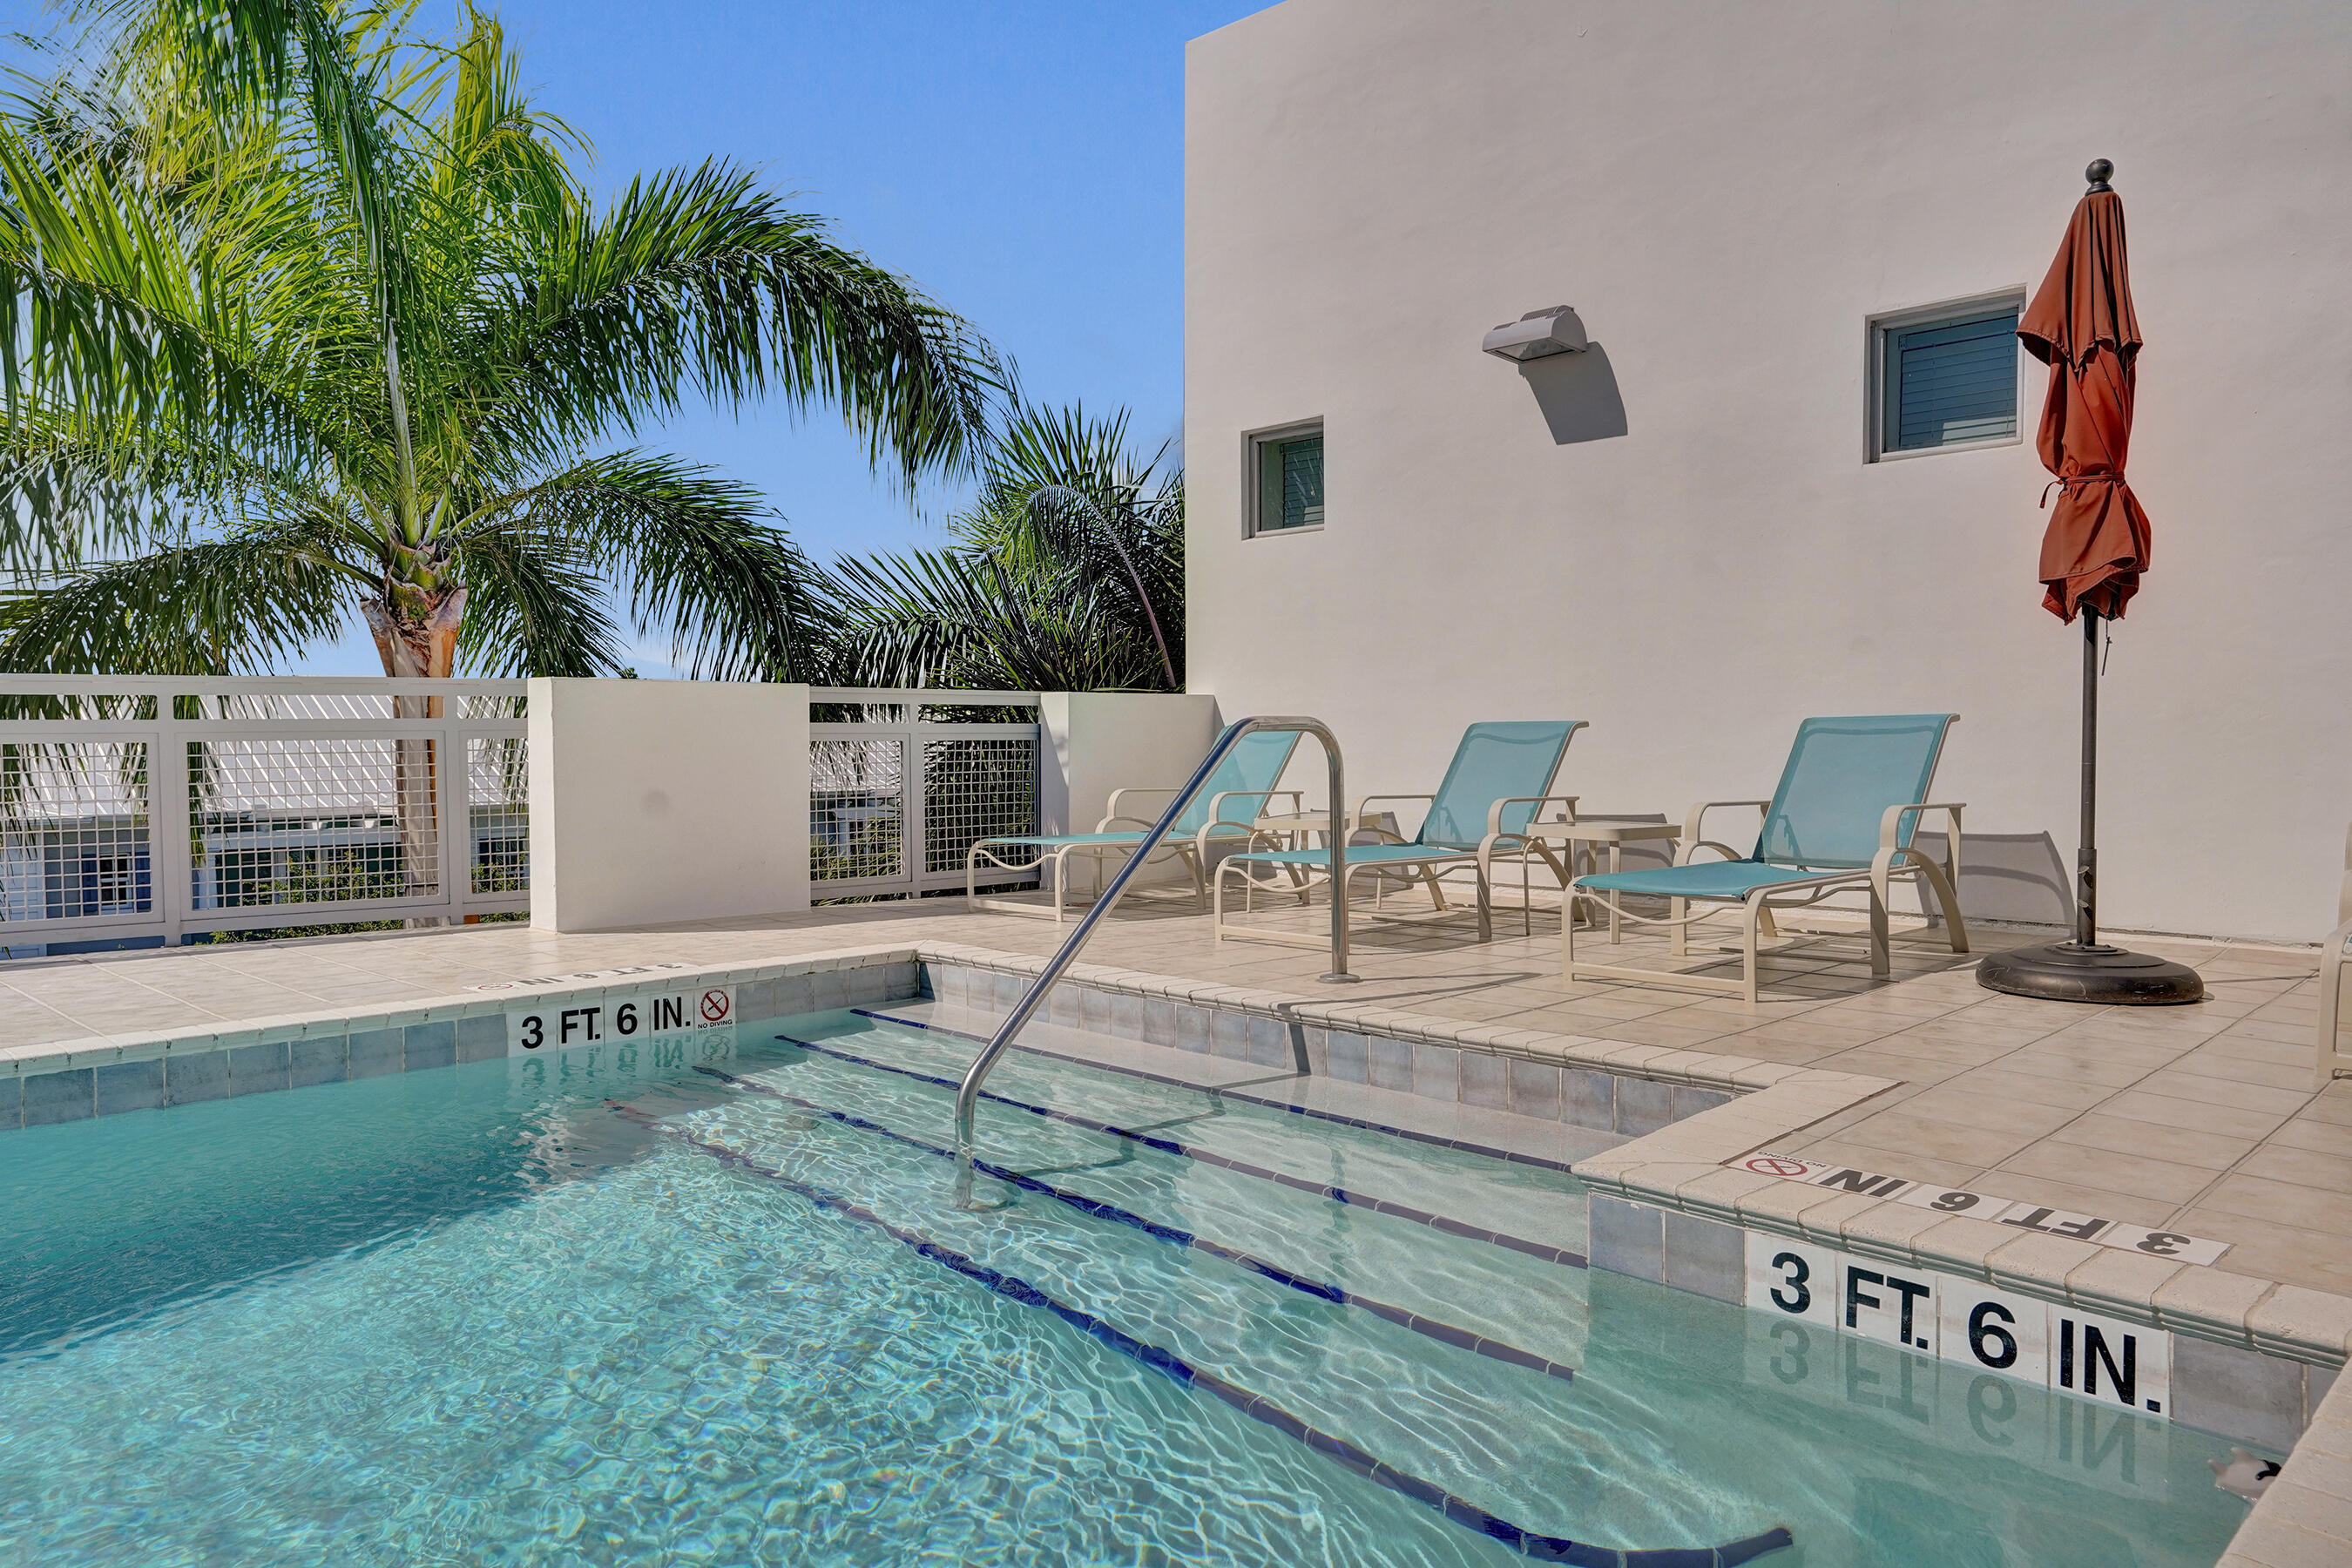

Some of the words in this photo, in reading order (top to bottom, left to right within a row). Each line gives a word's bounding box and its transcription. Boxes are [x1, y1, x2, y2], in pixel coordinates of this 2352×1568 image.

[517, 977, 564, 986] IN
[611, 967, 653, 976] FT
[521, 1016, 544, 1049] 3
[561, 1006, 601, 1044] FT.
[616, 1003, 639, 1036] 6
[653, 996, 691, 1031] IN.
[1757, 1151, 1802, 1164] DIVING
[1818, 1169, 1909, 1198] IN
[1930, 1192, 1980, 1212] 6
[2001, 1207, 2111, 1240] FT
[2136, 1233, 2192, 1255] 3
[1770, 1252, 1811, 1314] 3
[1846, 1265, 1930, 1350] FT.
[1968, 1301, 2017, 1369] 6
[2060, 1317, 2161, 1414] IN.
